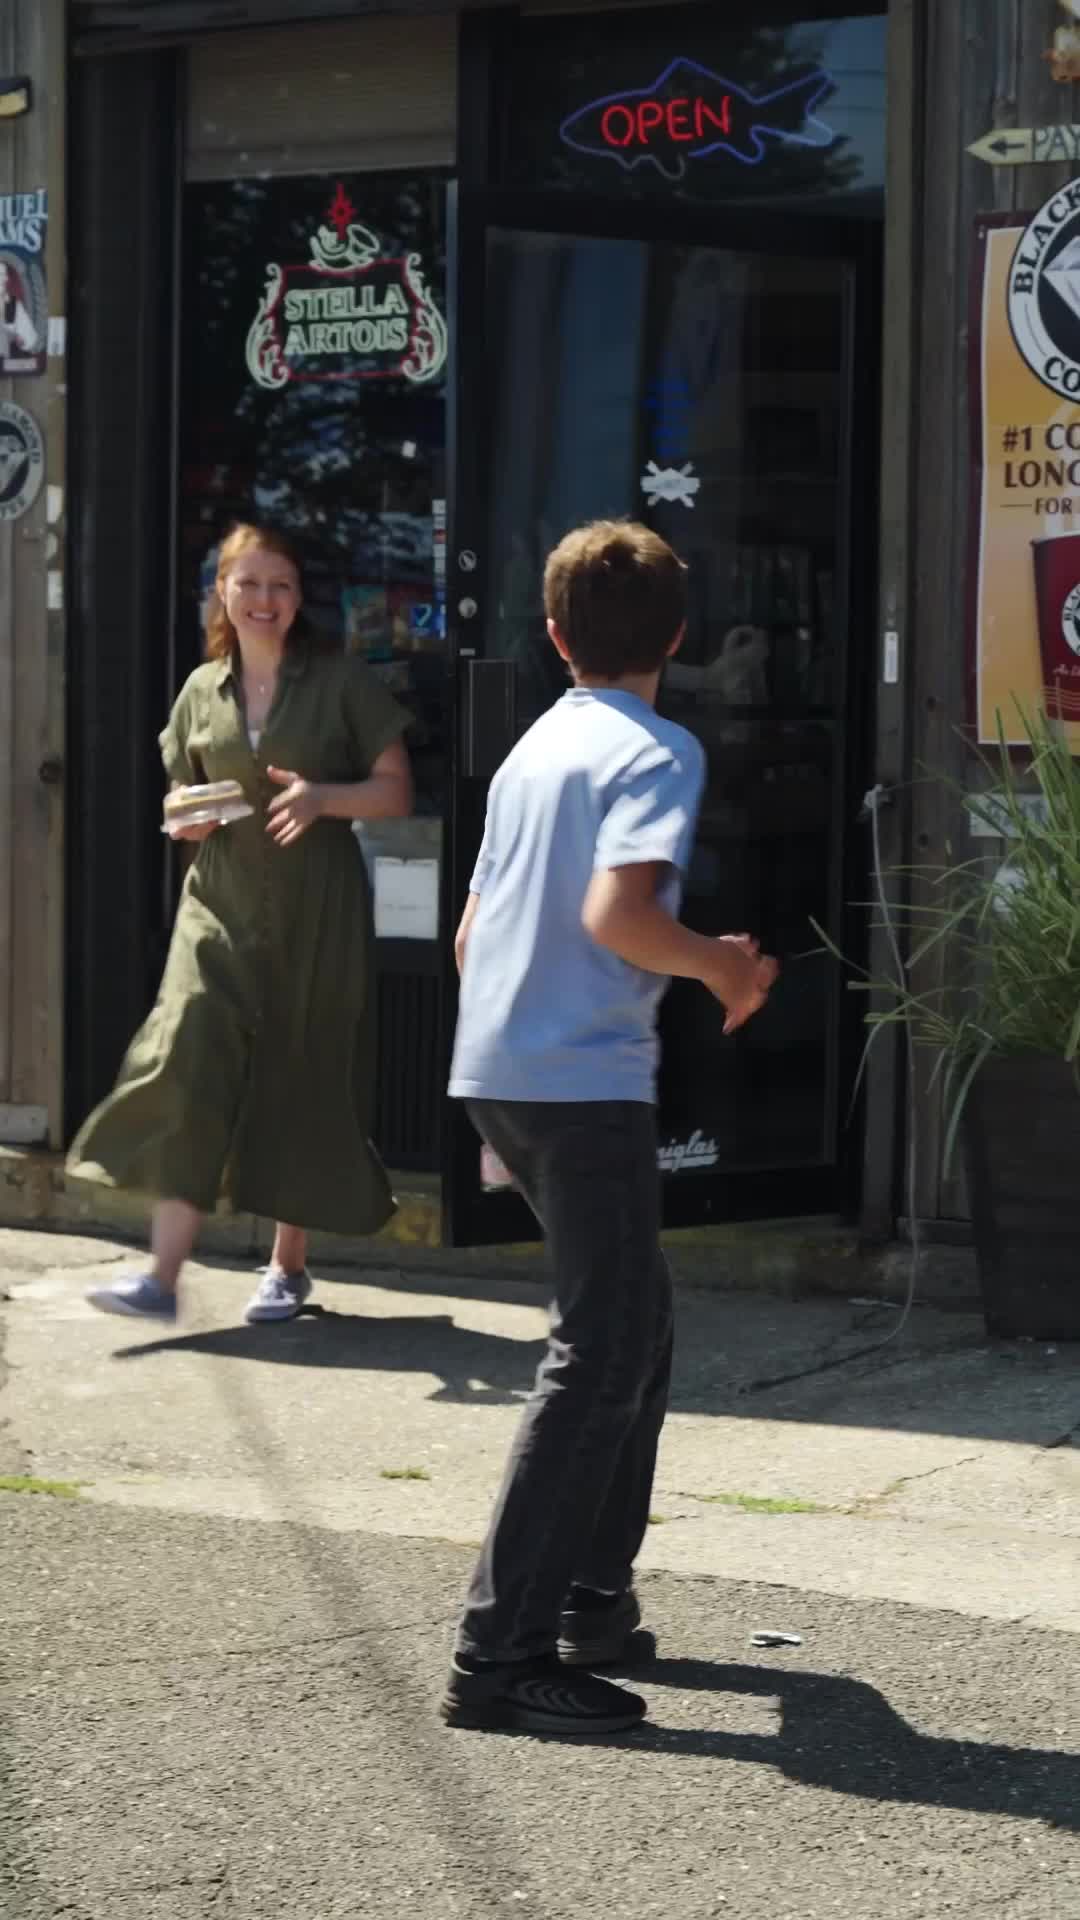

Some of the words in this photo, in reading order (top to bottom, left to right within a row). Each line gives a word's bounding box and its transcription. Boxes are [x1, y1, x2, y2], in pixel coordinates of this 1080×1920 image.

[601, 96, 731, 146] OPEN
[284, 284, 409, 321] STELLA
[284, 318, 409, 355] ARTOIS
[1002, 426, 1032, 453] #1
[1035, 497, 1073, 515] FOR
